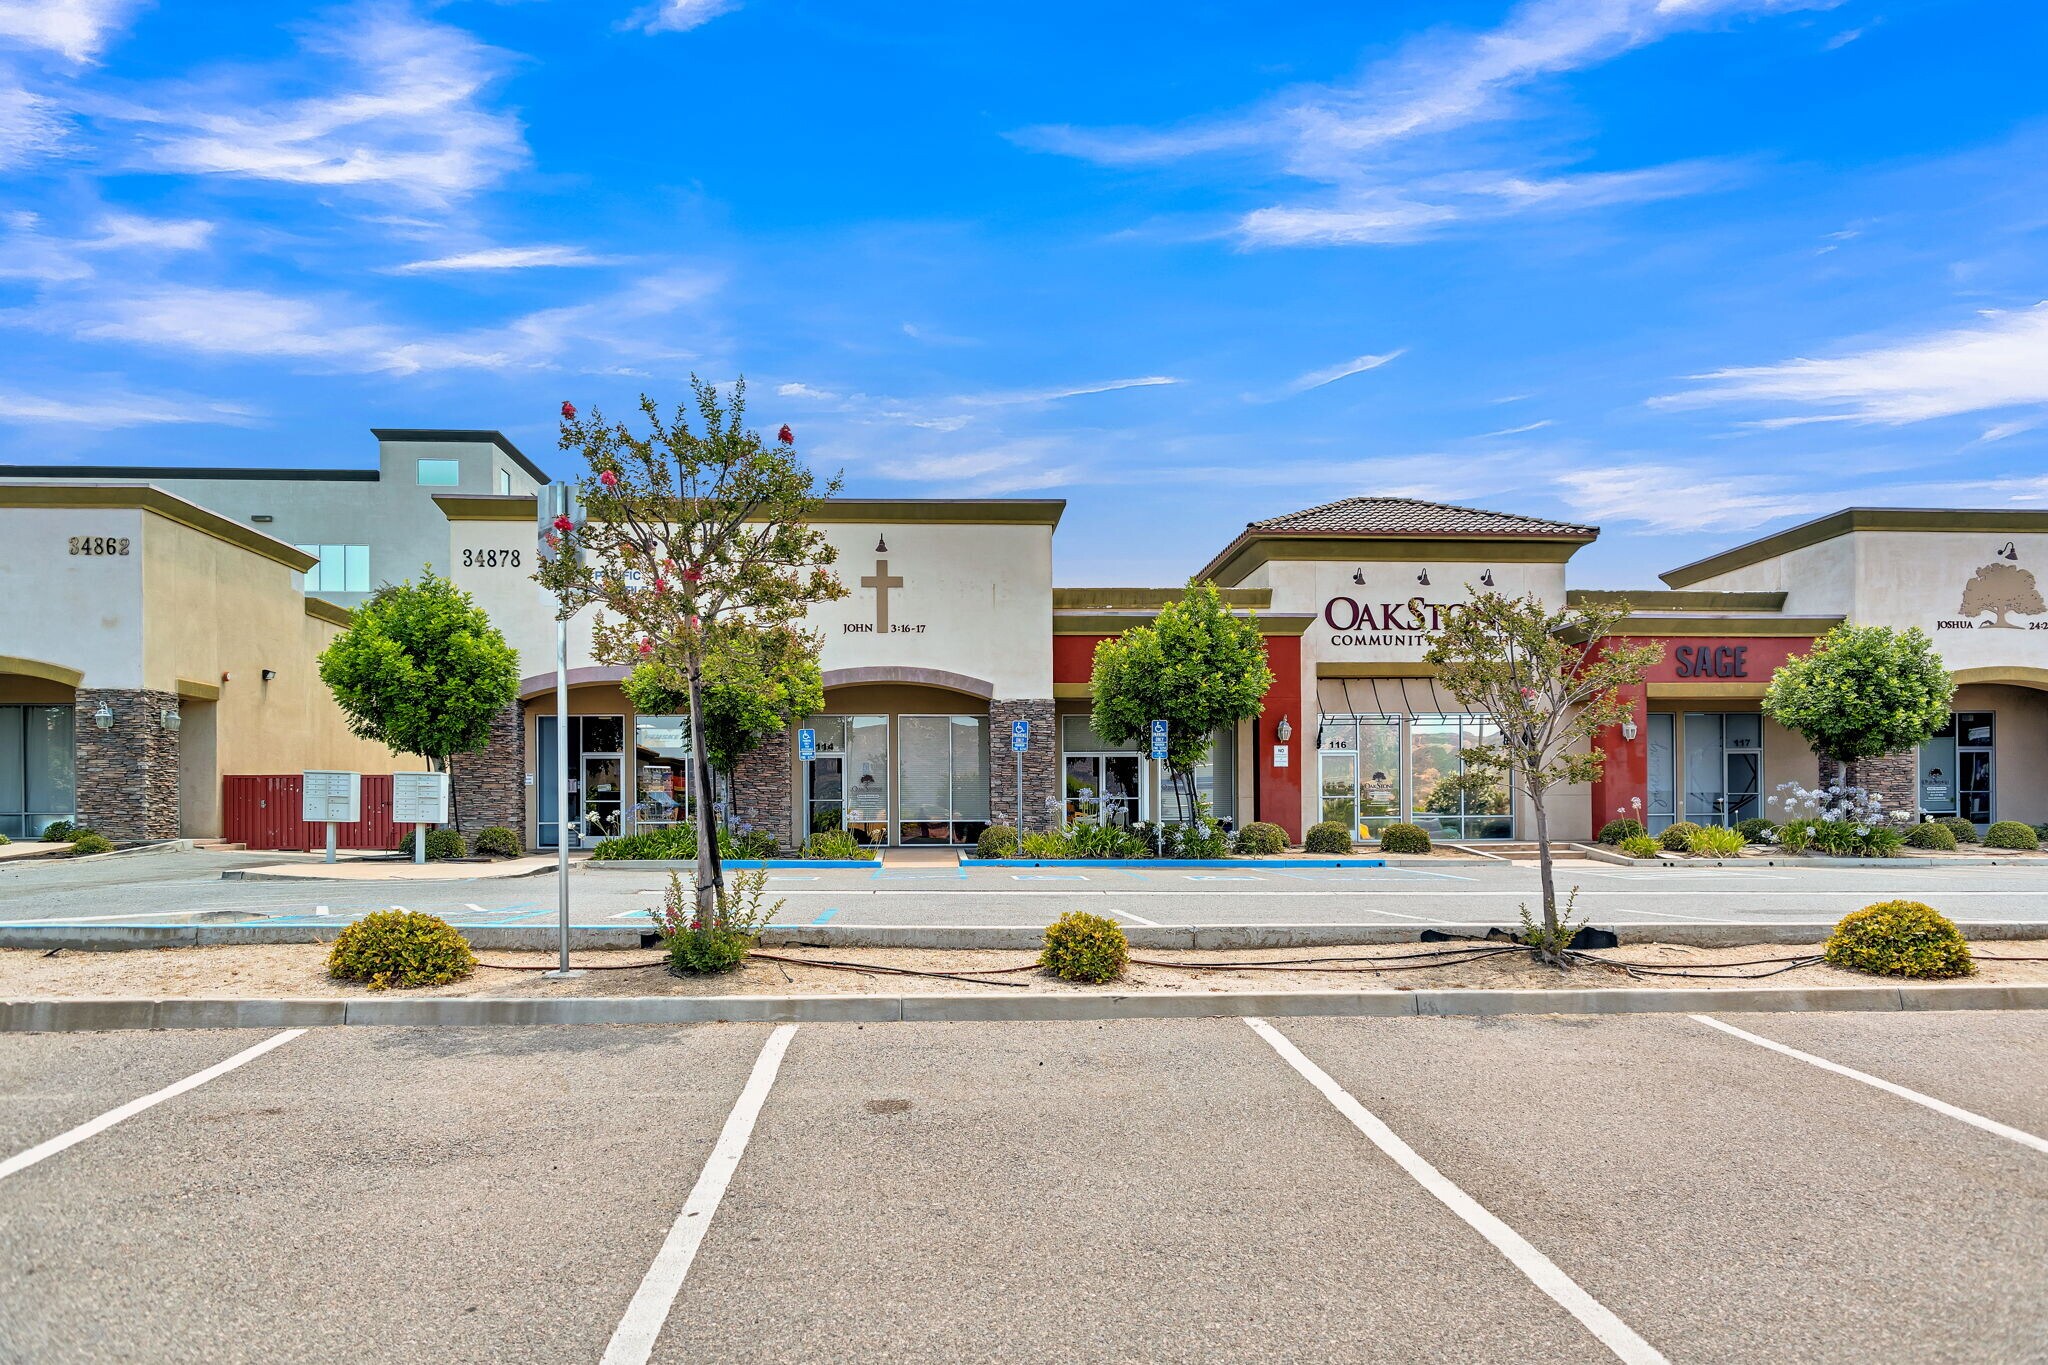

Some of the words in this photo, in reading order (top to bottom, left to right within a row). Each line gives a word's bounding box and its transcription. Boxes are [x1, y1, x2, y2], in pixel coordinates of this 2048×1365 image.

[69, 537, 130, 556] 34862
[463, 549, 521, 568] 34878
[843, 623, 873, 635] JOHN
[891, 624, 926, 633] 3:16-17
[1936, 620, 1974, 631] JOSHUA
[1676, 645, 1748, 678] SAGE
[815, 742, 834, 750] 114
[1329, 741, 1347, 749] 116
[1734, 738, 1750, 747] 117
